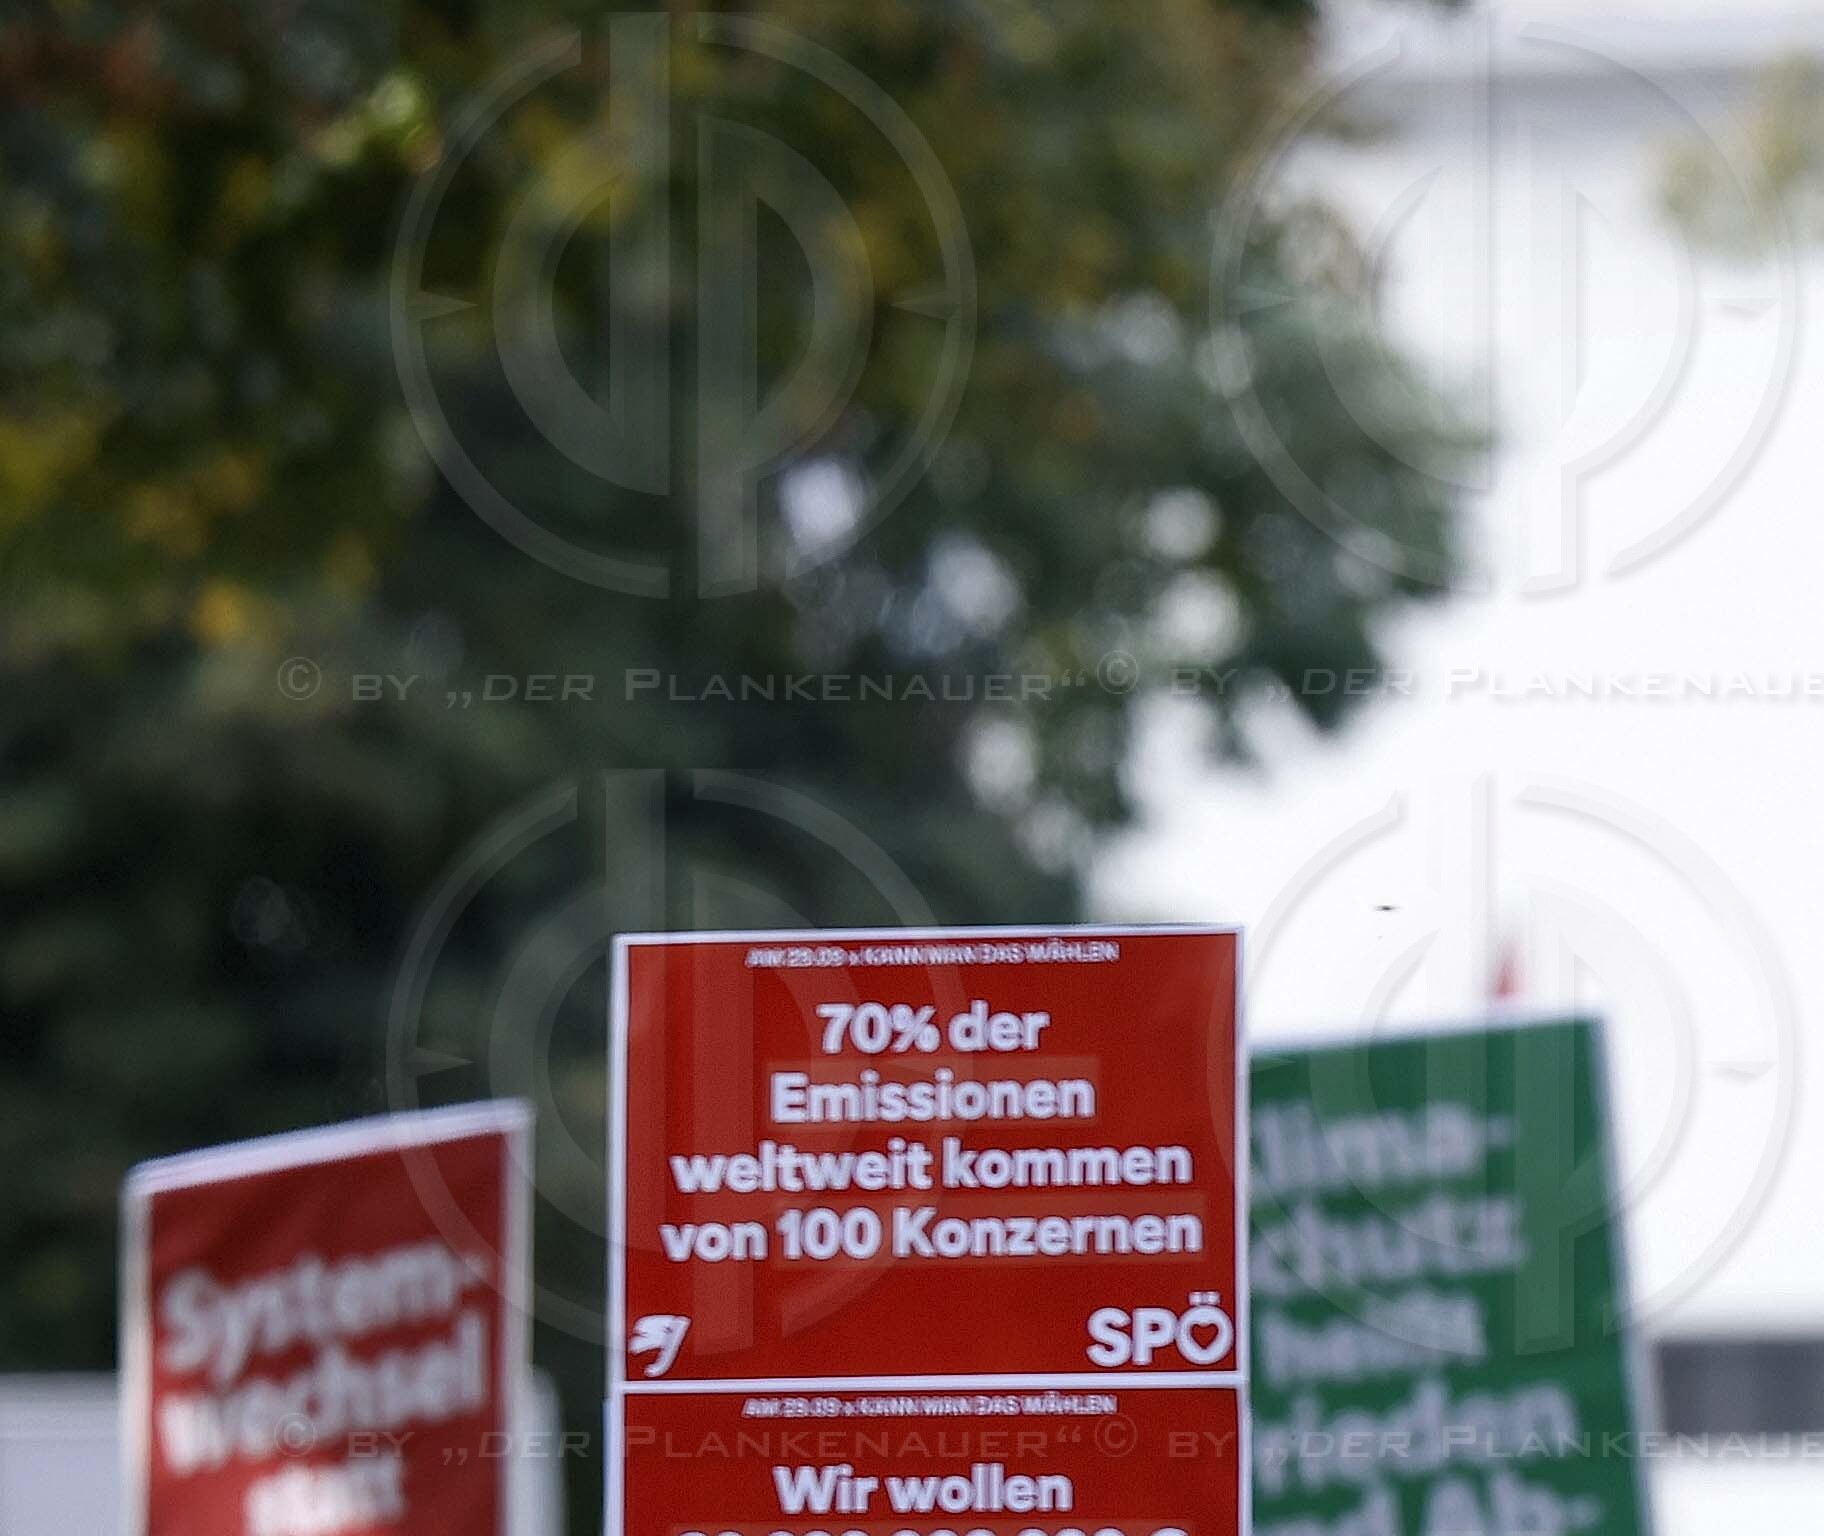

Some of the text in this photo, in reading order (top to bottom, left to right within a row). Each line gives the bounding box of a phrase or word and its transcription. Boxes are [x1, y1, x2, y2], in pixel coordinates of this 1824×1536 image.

[817, 1002, 1048, 1052] 70% der
[770, 1070, 1095, 1122] Emissionen
[671, 1139, 1190, 1192] weltweit kommen
[1252, 1101, 1517, 1192] lima-
[661, 1207, 1201, 1261] von 100 Konzernen
[1252, 1199, 1526, 1293] chutz
[1087, 1293, 1232, 1367] SPÖ
[773, 1464, 1071, 1512] Wir wollen
